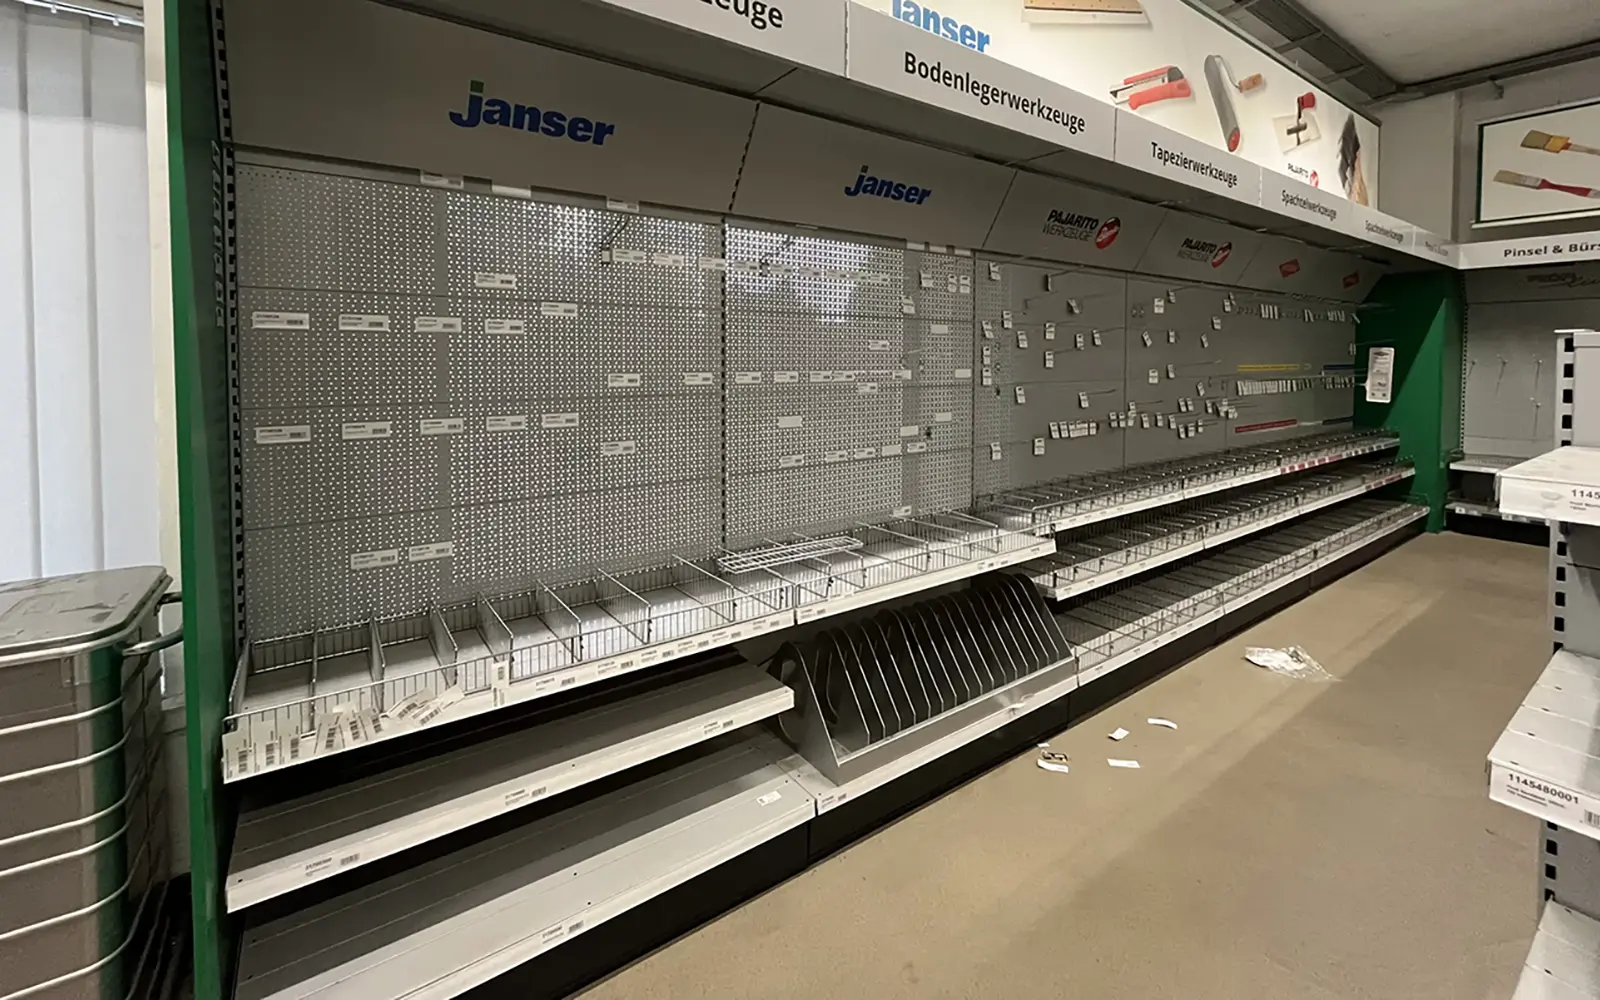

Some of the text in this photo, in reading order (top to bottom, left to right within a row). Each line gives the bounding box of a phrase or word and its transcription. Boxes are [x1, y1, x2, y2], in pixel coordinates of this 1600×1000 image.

[701, 0, 783, 30] euge
[903, 51, 1086, 135] Bodenlegerwerkzeuge
[449, 80, 615, 145] janser
[1150, 141, 1238, 188] Tapezierwerkzeuge
[843, 165, 932, 206] janser
[1047, 209, 1100, 230] PAJARITO
[1281, 189, 1338, 222] Spachtelwerkzeuge
[1181, 237, 1217, 254] PAJARITO
[1503, 245, 1548, 258] Pinsel
[1551, 245, 1563, 254] &
[1508, 773, 1579, 805] 1145480001
